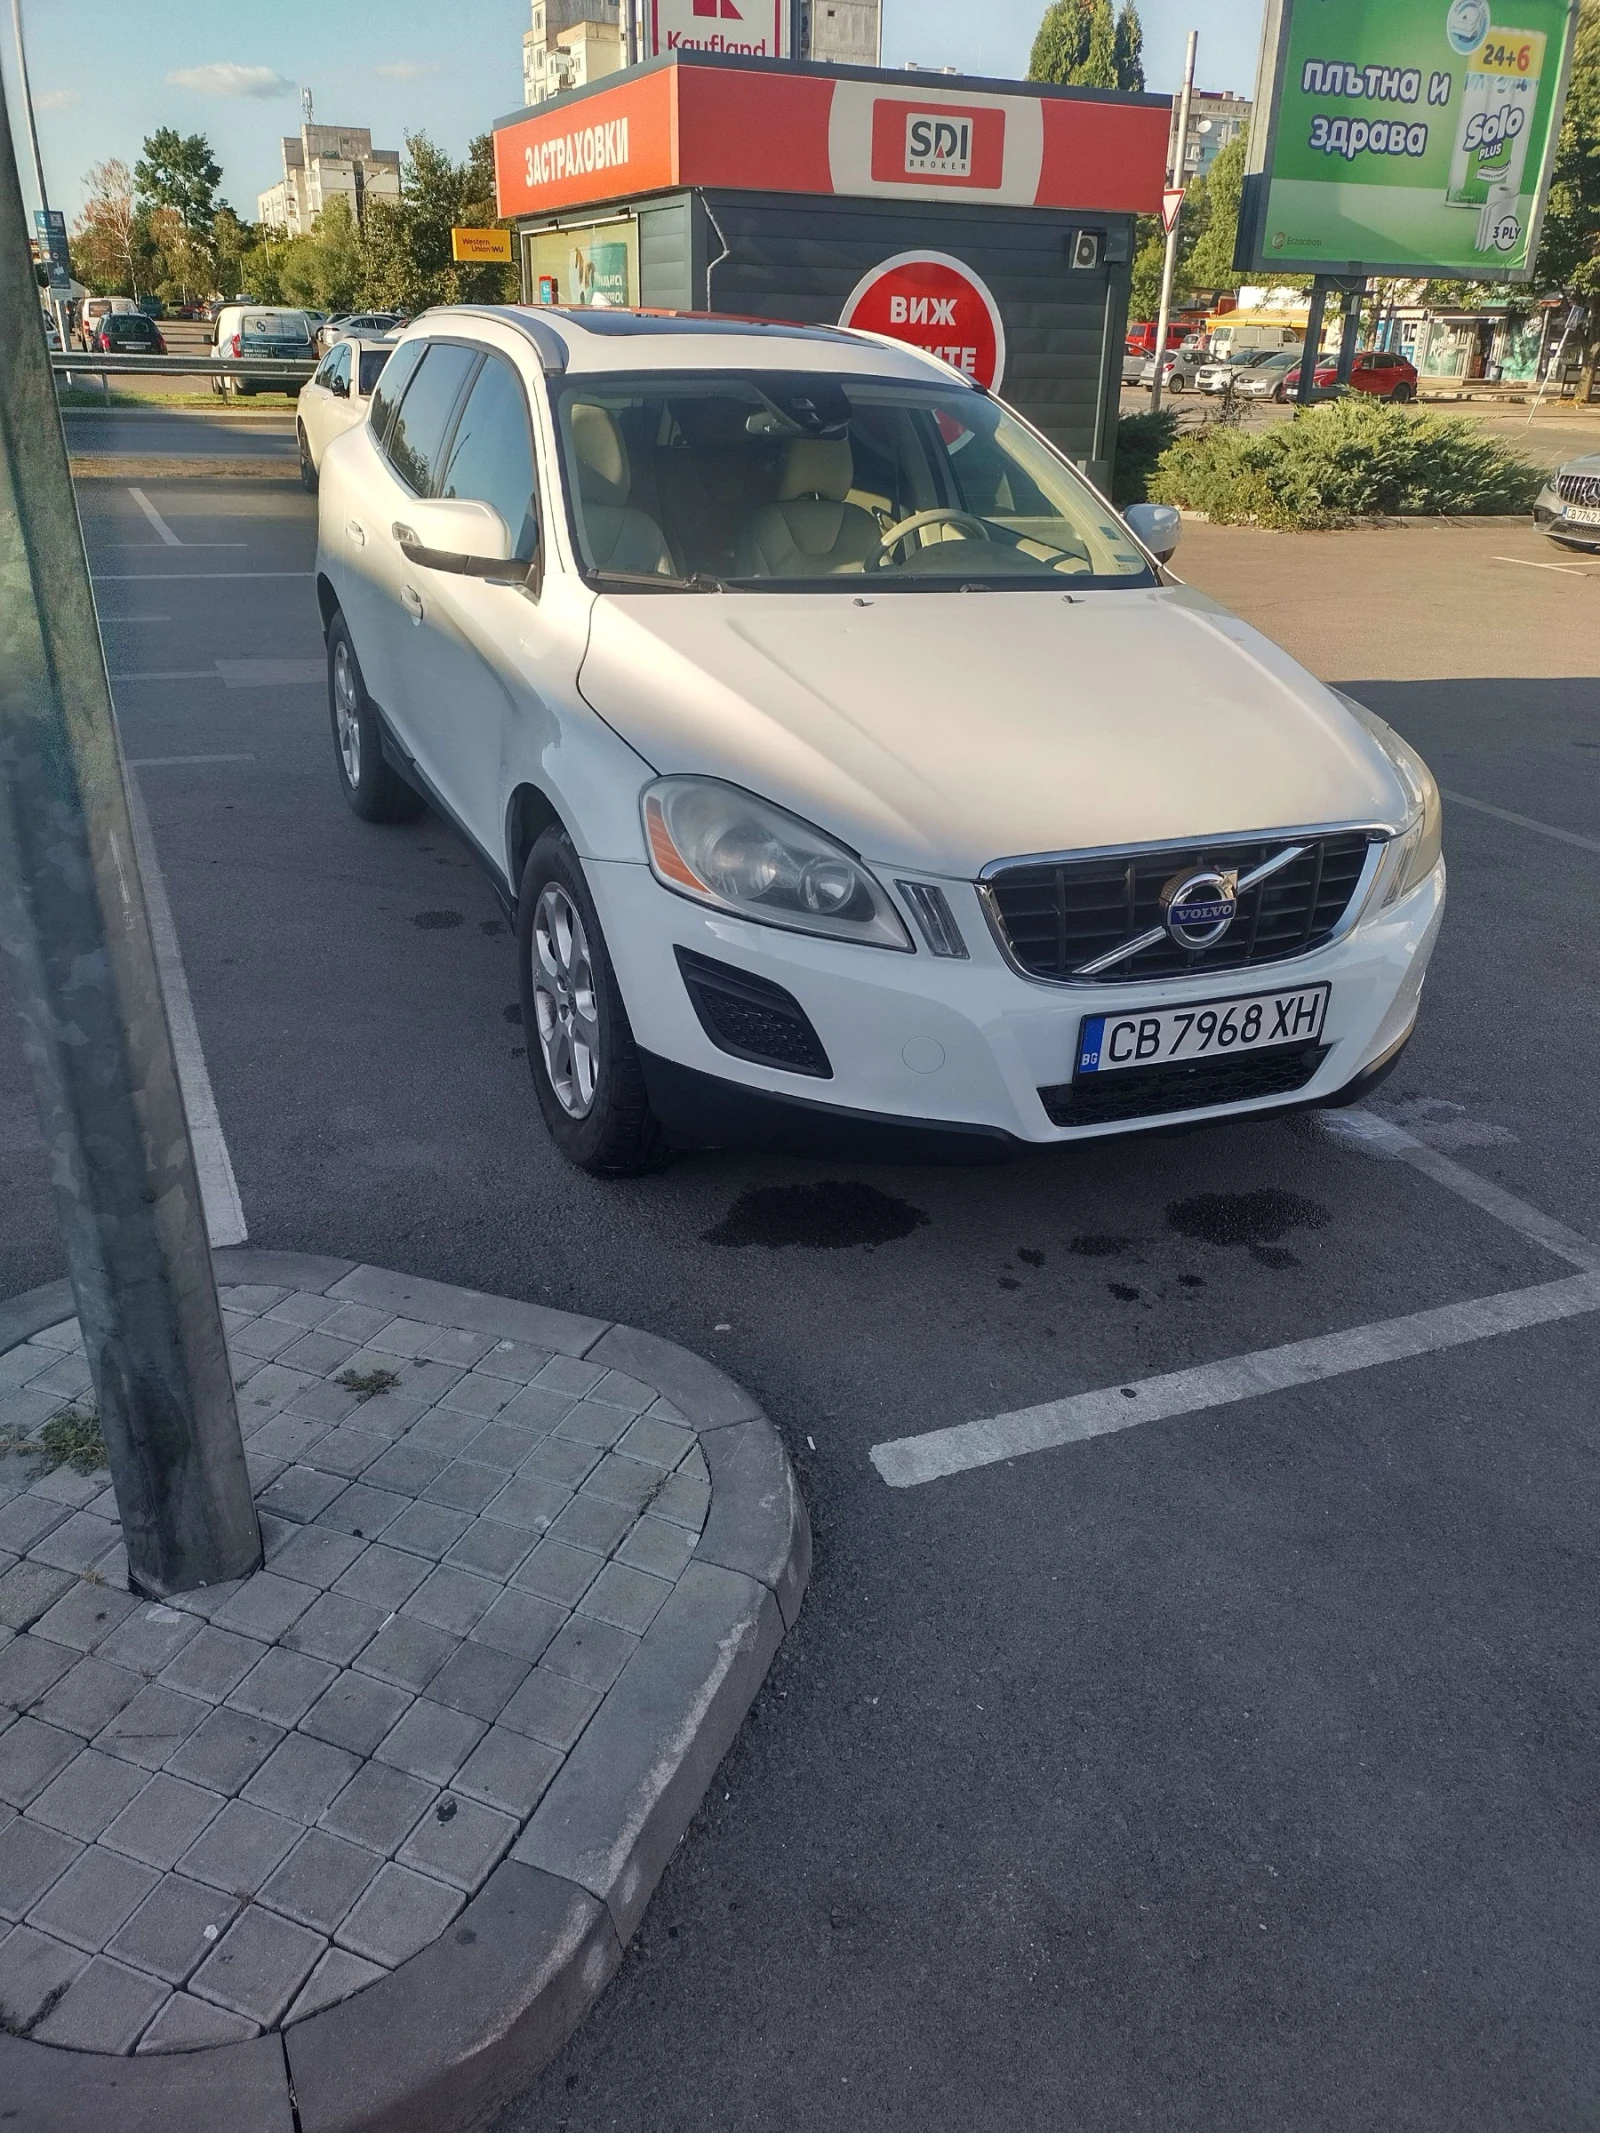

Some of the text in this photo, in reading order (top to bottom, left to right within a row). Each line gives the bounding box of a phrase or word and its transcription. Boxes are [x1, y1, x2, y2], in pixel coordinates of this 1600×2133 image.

[667, 31, 766, 56] Kaufland
[1482, 44, 1532, 71] 24+6
[1302, 60, 1451, 106] плътна и
[910, 121, 968, 160] SDI
[1309, 115, 1428, 161] здрава
[1462, 104, 1524, 152] Solo
[525, 117, 629, 187] ЗАСТРАХОВКИ
[909, 159, 967, 170] BROKER
[1478, 142, 1503, 162] PLUS
[1492, 226, 1522, 240] 3 PLY
[890, 296, 958, 326] ВИЖ
[1176, 904, 1232, 920] VOLVO
[1169, 1004, 1263, 1054] 7968
[1081, 1052, 1099, 1066] BG
